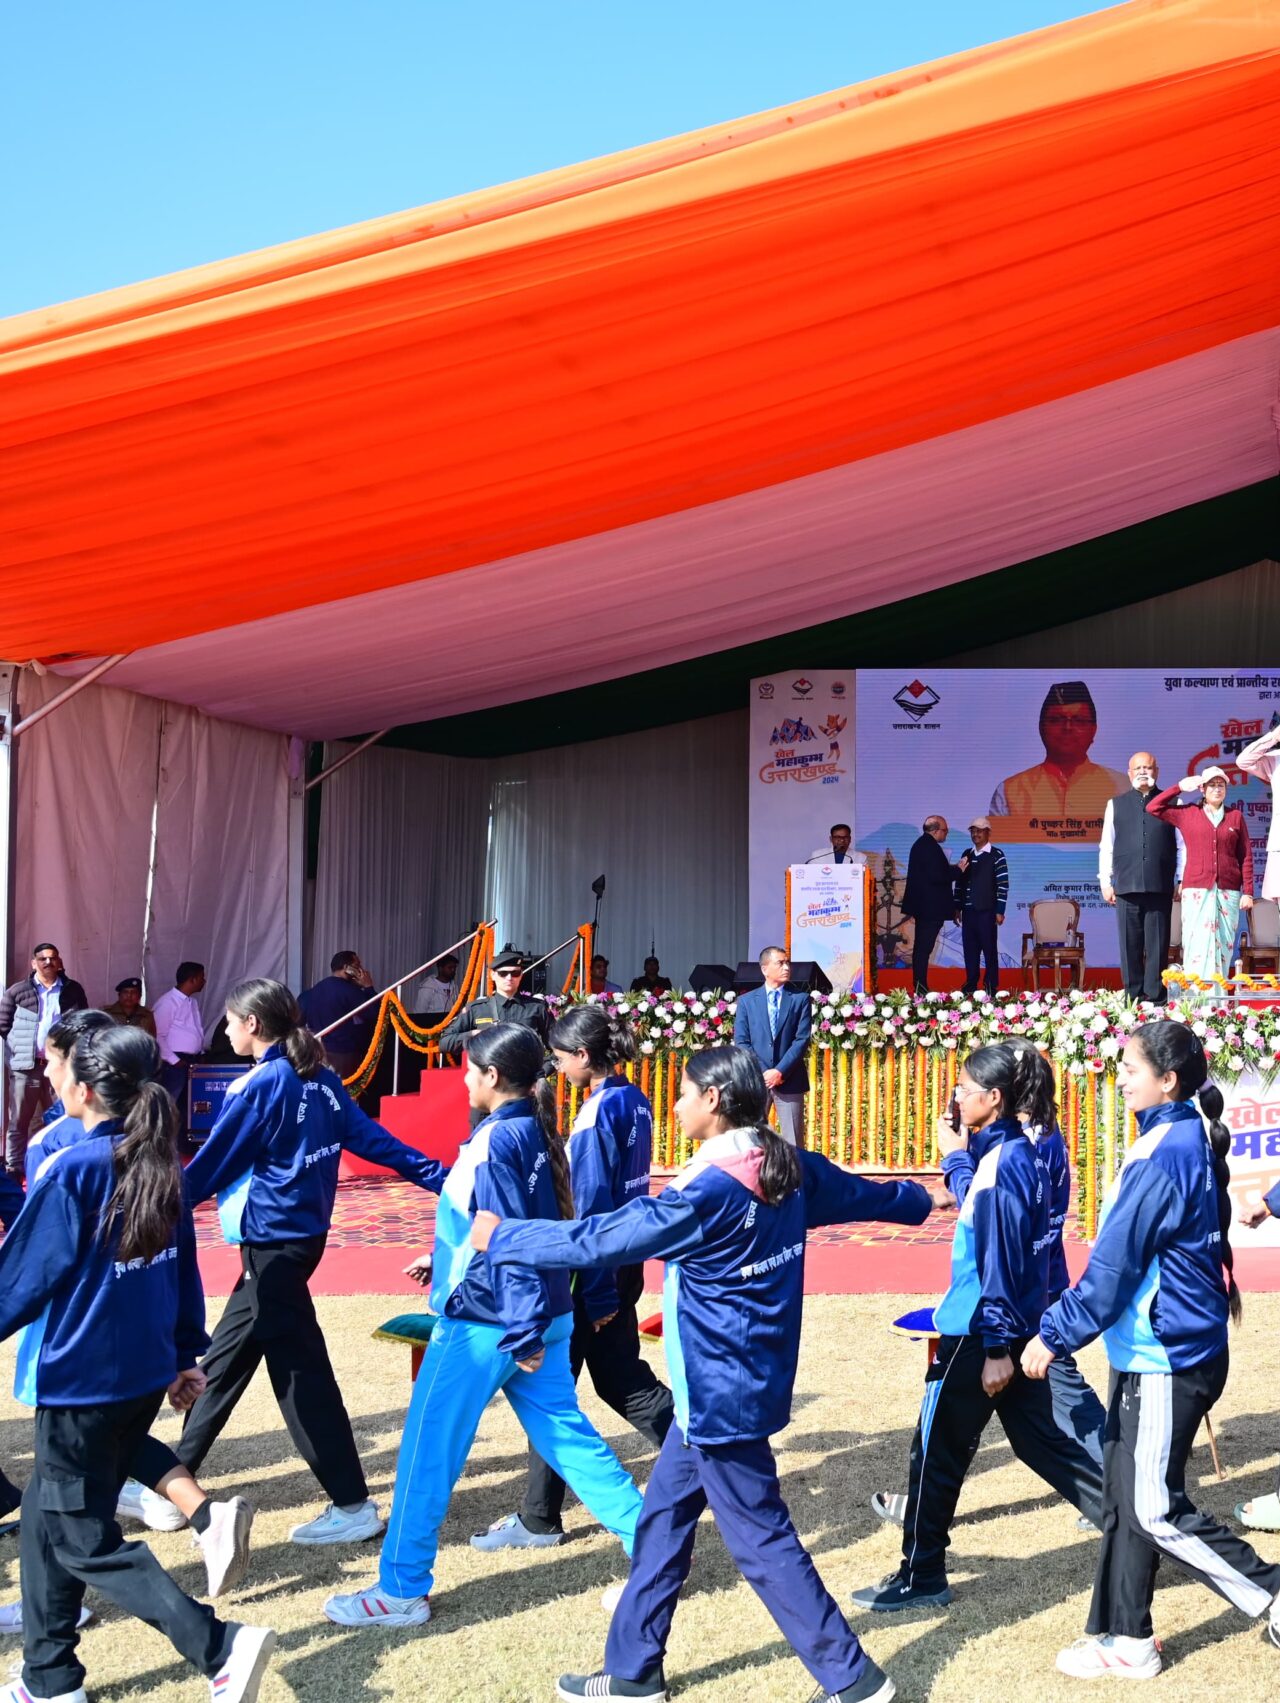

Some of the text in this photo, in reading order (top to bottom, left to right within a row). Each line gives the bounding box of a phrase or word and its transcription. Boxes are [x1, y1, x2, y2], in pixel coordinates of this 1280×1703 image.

[1164, 677, 1182, 692] युवा
[1183, 677, 1220, 688] कल्याण
[1221, 675, 1234, 688] एवं
[1220, 719, 1263, 739] खेल
[775, 748, 795, 759] खेल
[775, 753, 824, 768] महाकुम्भ
[759, 762, 848, 784] उत्तराखण्ड
[1066, 818, 1083, 829] सिंह
[1043, 884, 1061, 892] अमित
[1063, 885, 1082, 894] कुमार
